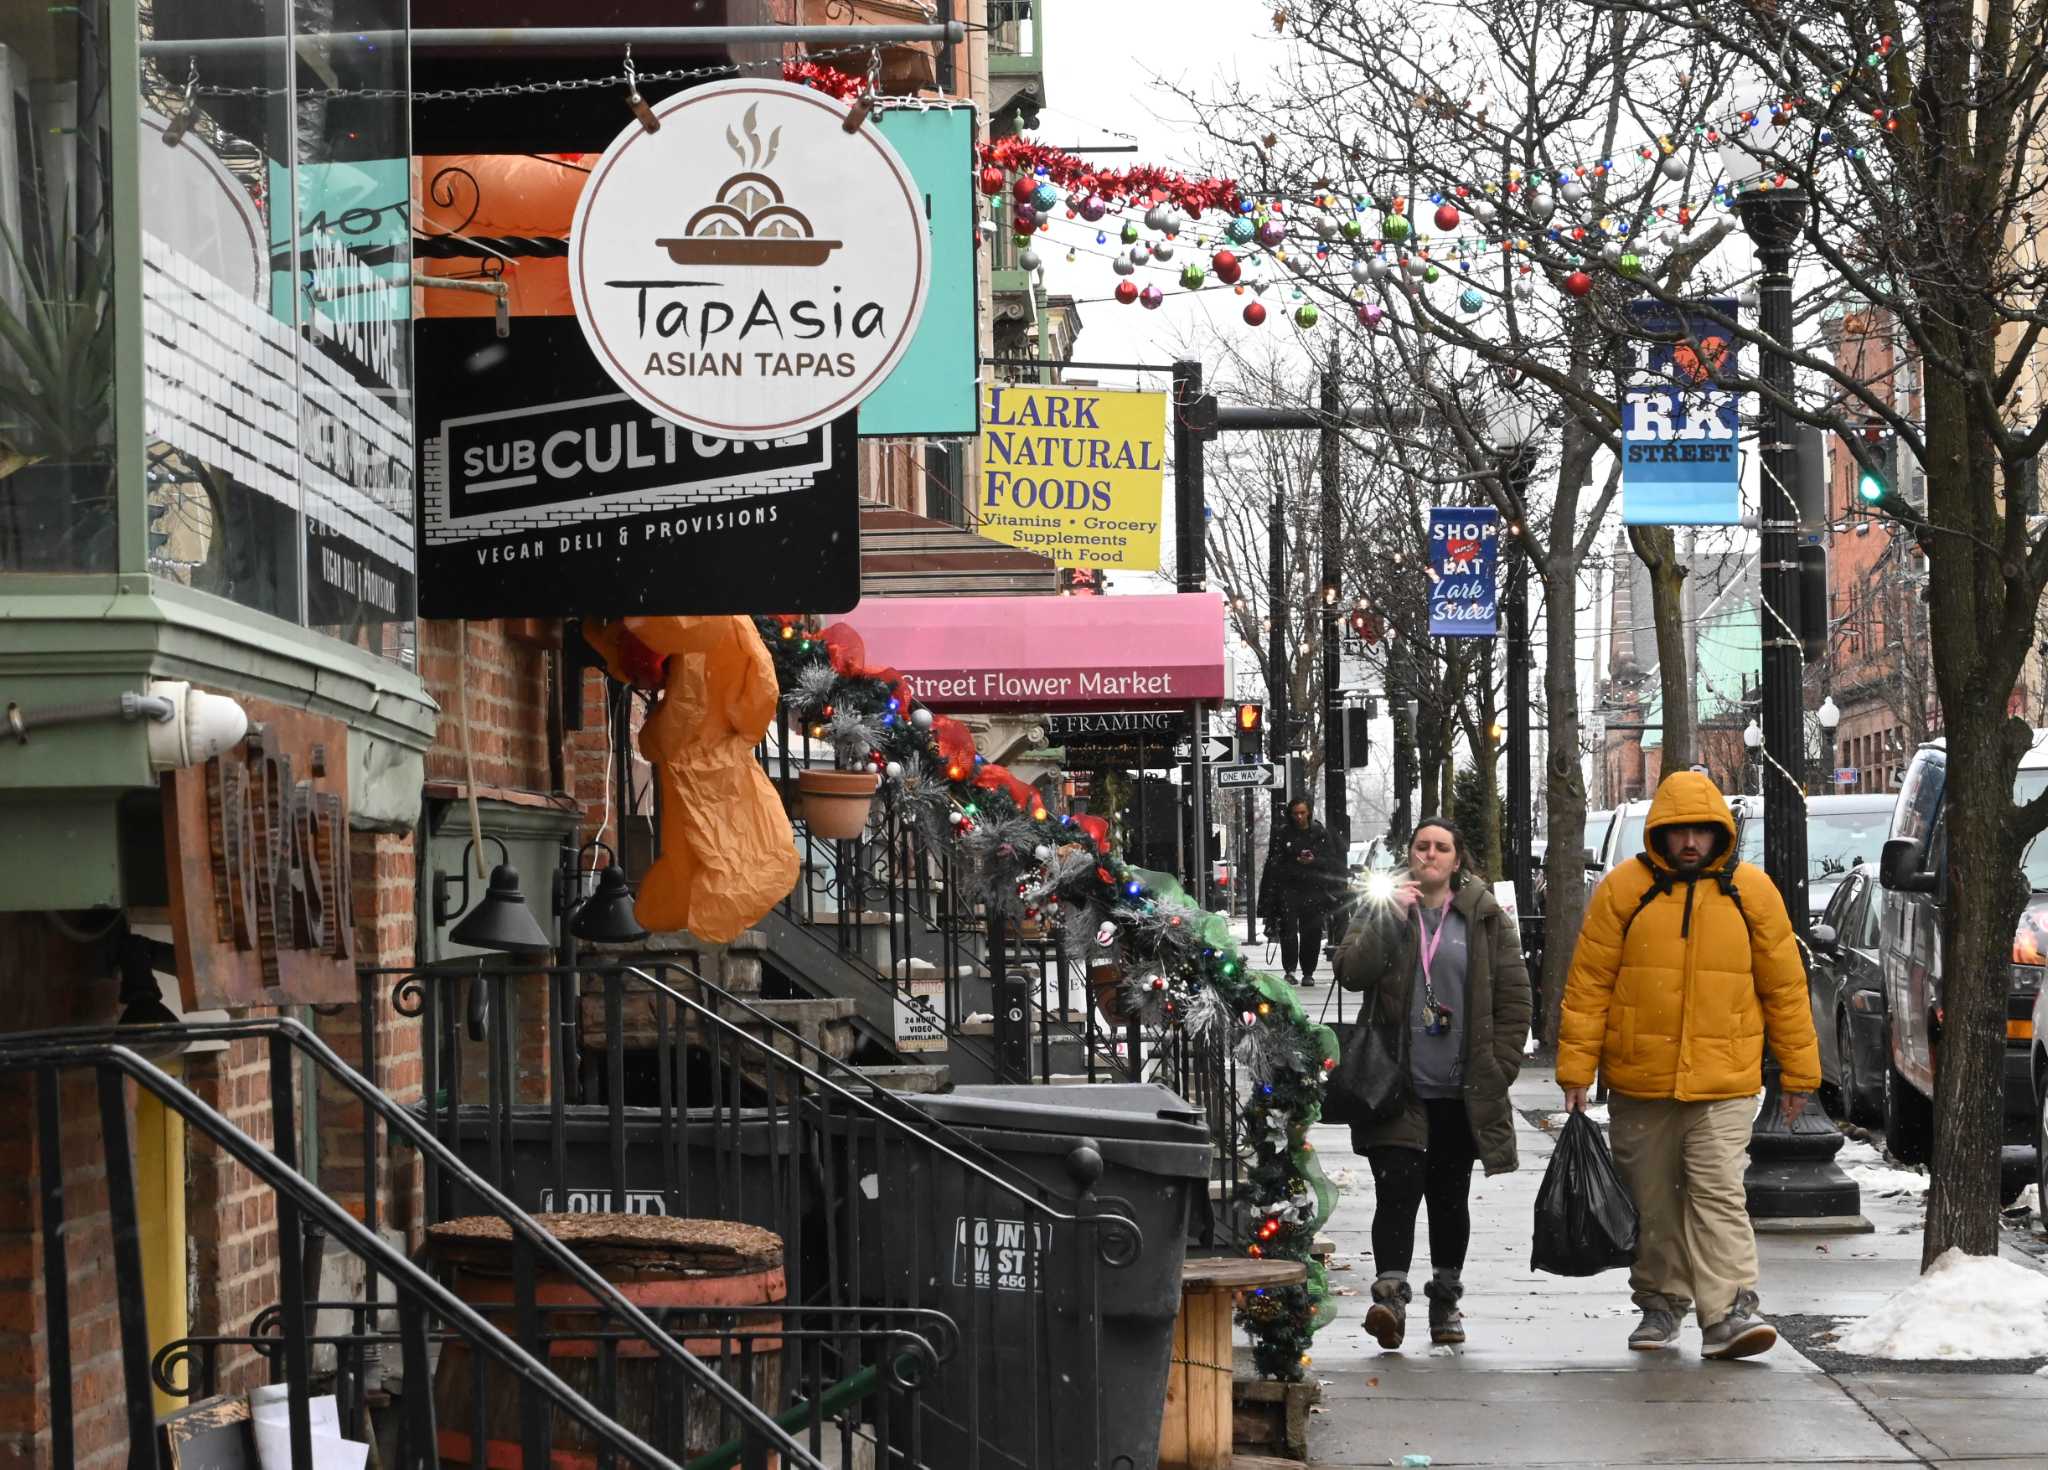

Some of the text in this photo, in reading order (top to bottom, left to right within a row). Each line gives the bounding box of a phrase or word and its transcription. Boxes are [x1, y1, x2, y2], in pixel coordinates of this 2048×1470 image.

[604, 280, 886, 351] TapAsia
[644, 352, 856, 378] ASIAN TAPAS
[987, 387, 1100, 429] LARK
[985, 431, 1161, 471] NATURAL
[1628, 444, 1733, 463] STREET
[984, 470, 1112, 512] FOODS
[984, 513, 1157, 534] Vitamins Grocery
[1433, 523, 1496, 541] SHOP
[477, 505, 779, 565] VEGAN DELI & PROVISIONS
[1013, 530, 1127, 546] Supplements
[1024, 547, 1123, 562] alth Food
[1432, 579, 1485, 600] Lark
[1433, 601, 1496, 621] Street
[901, 671, 1172, 697] Street Flower Market
[1066, 713, 1170, 732] FRAMING
[1222, 771, 1257, 781] ONE WAY
[904, 1016, 914, 1024] 24
[910, 1025, 932, 1033] VIDEO
